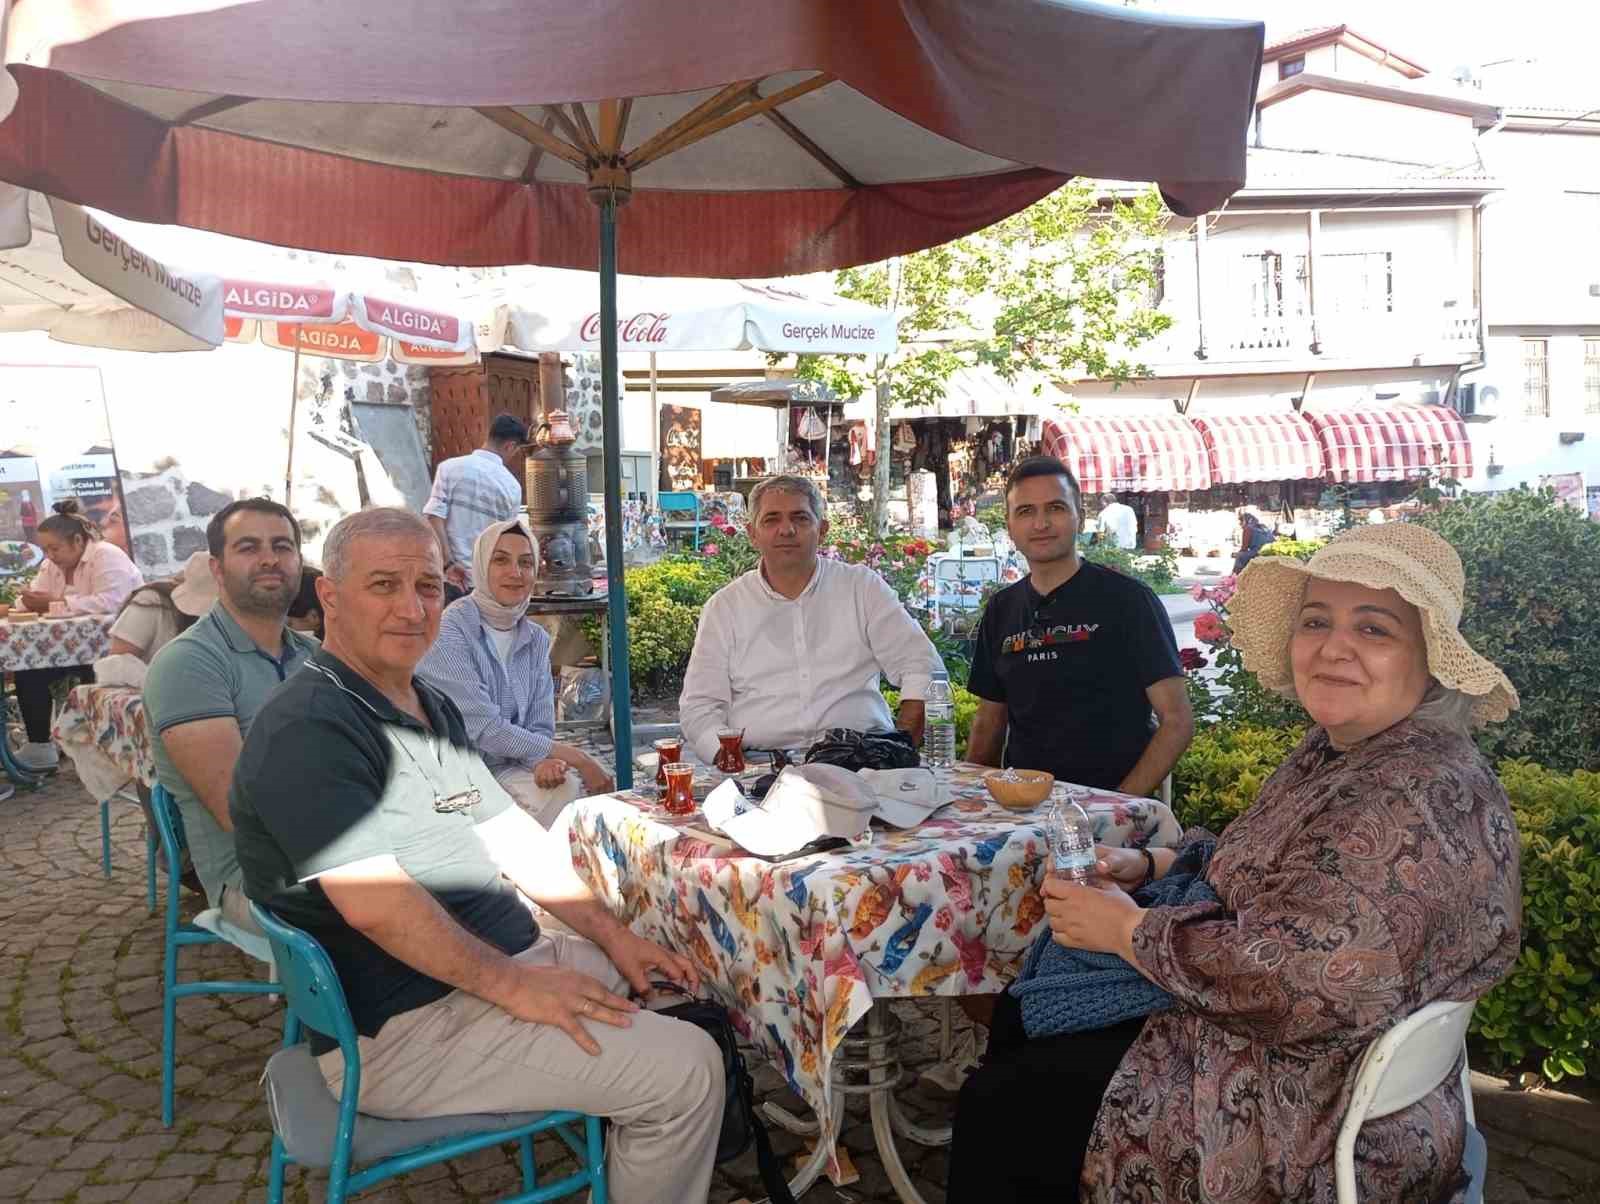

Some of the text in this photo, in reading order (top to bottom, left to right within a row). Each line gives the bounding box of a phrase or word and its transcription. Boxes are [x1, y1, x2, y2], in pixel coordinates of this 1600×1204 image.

[580, 312, 672, 343] Co-Cola
[782, 322, 875, 343] Gerçek Mucize
[1027, 650, 1059, 663] PARIS
